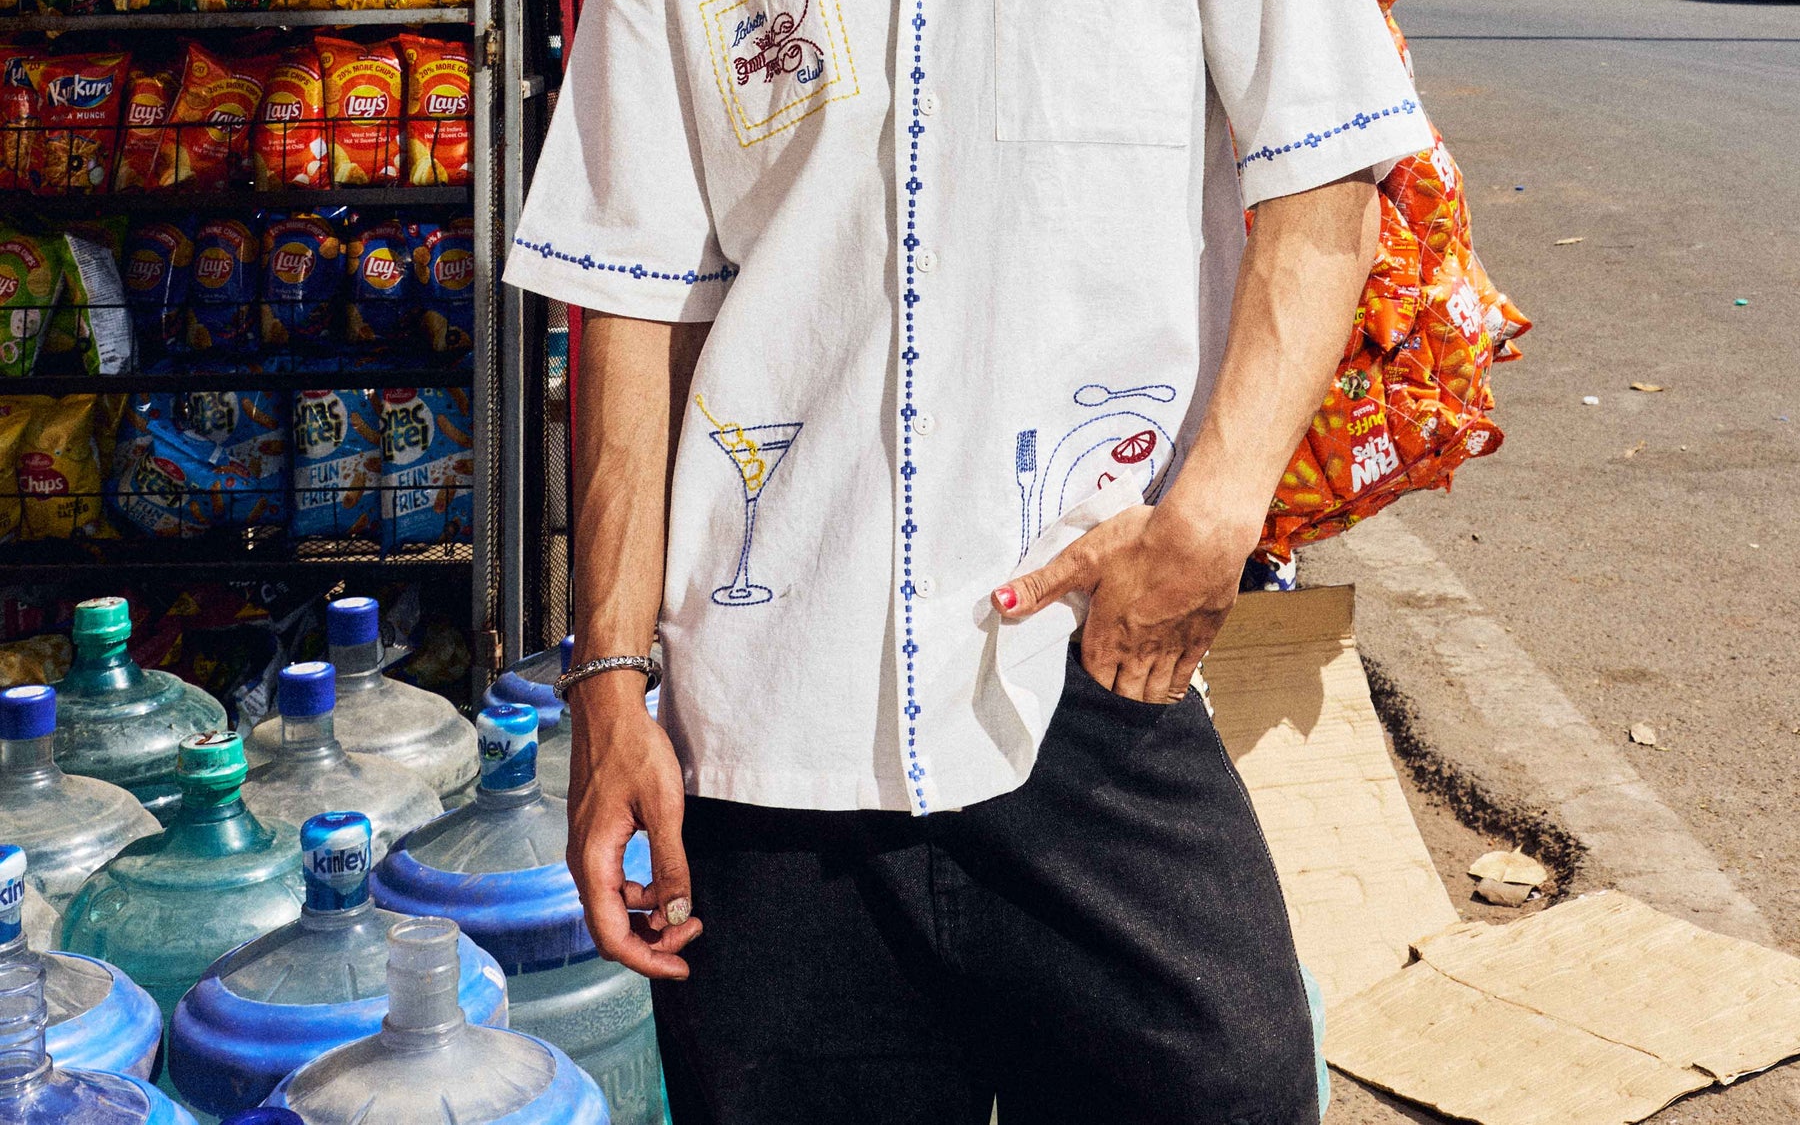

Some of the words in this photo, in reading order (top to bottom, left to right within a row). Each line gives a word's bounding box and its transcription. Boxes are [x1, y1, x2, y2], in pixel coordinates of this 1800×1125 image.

[336, 67, 352, 81] 20%
[353, 63, 373, 72] MORE
[375, 64, 396, 80] CHIPS
[419, 66, 434, 79] 20%
[436, 63, 456, 71] MORE
[796, 51, 825, 84] Club
[290, 72, 310, 86] CHIPS
[48, 74, 113, 107] Kurkure
[76, 111, 105, 120] MUNCH
[128, 104, 166, 125] Lay's
[266, 102, 301, 122] Lay's
[348, 95, 386, 118] Lay's
[428, 94, 467, 116] Lay's
[198, 257, 231, 279] Lay's
[277, 250, 312, 274] Lay's
[439, 256, 474, 282] Lay's
[1353, 403, 1375, 416] Masala
[1353, 432, 1391, 463] FLIPS
[309, 461, 339, 483] FUN
[398, 465, 429, 488] FUN
[1351, 441, 1400, 493] FUN
[19, 476, 64, 494] Chips
[479, 736, 511, 761] ley
[312, 846, 368, 875] kinley
